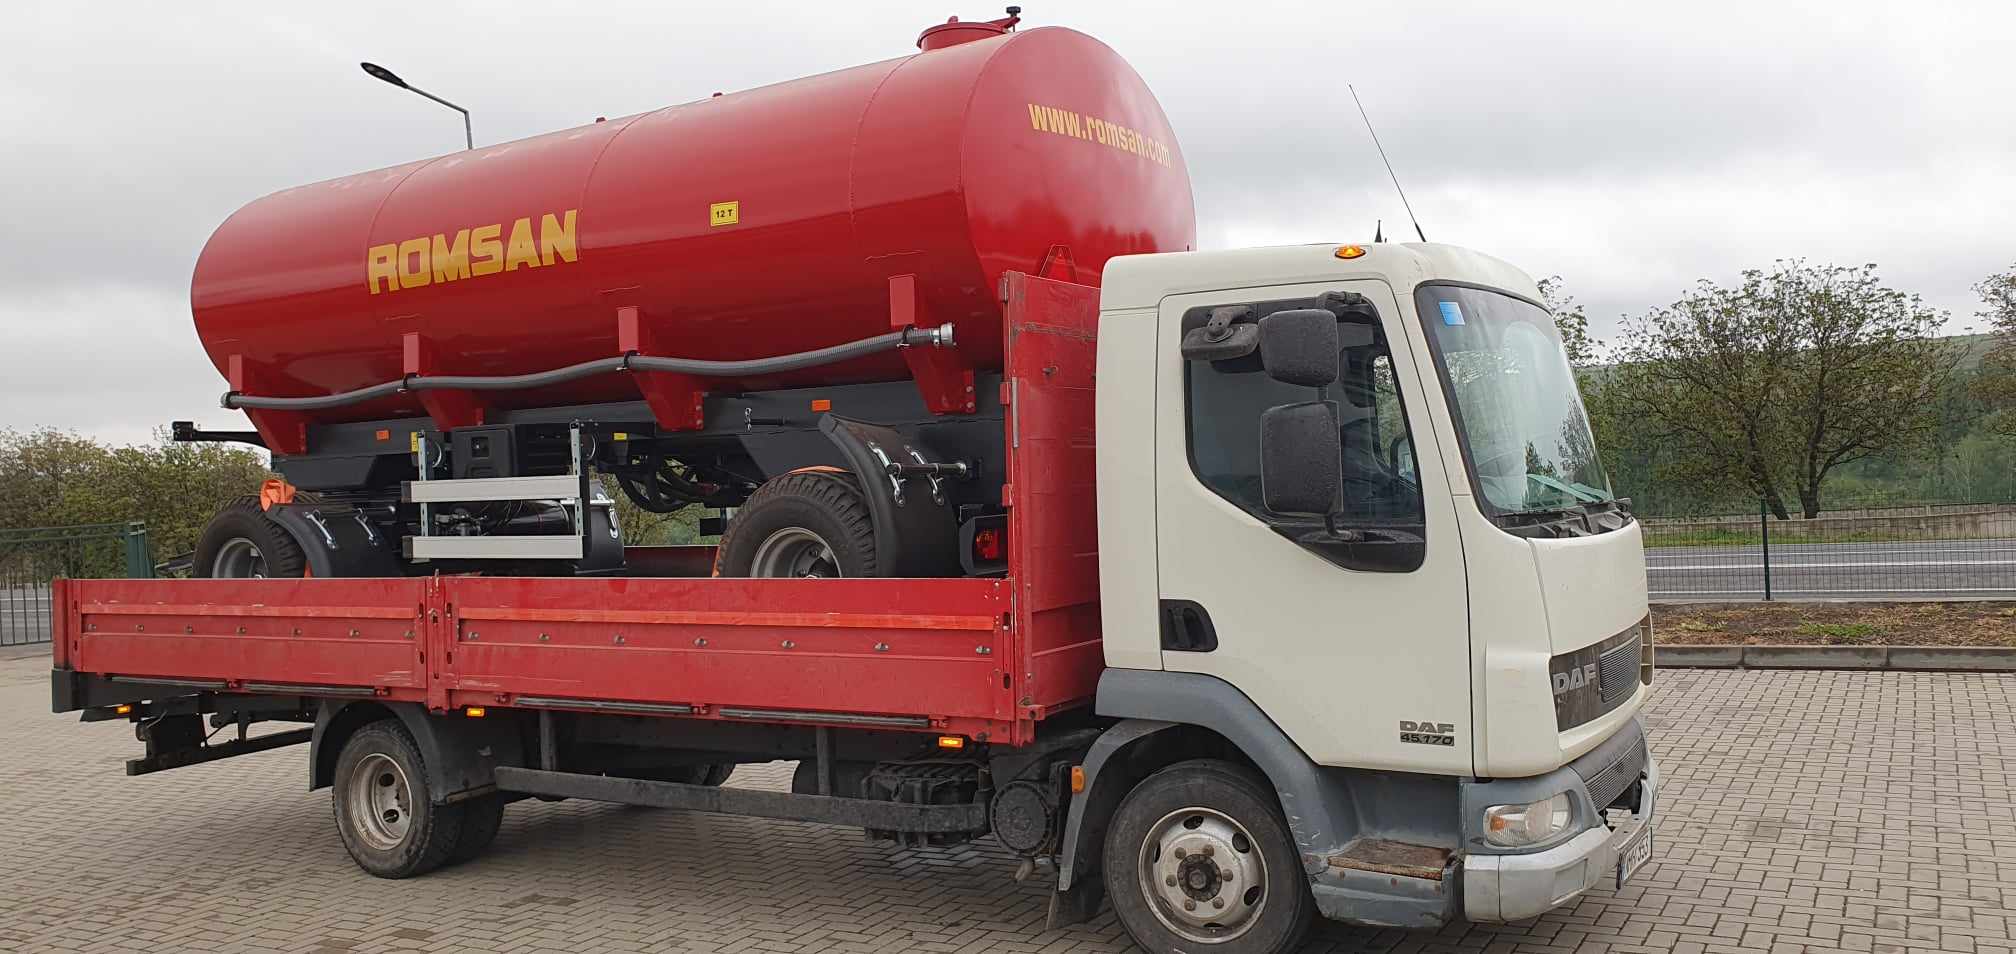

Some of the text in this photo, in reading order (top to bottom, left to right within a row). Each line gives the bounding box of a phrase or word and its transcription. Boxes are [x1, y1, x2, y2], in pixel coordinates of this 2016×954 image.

[1027, 103, 1172, 168] www.romsan.com
[716, 208, 733, 218] 12 T
[368, 209, 578, 295] ROMSAN
[1552, 662, 1597, 695] DAF
[1399, 720, 1454, 734] DAF
